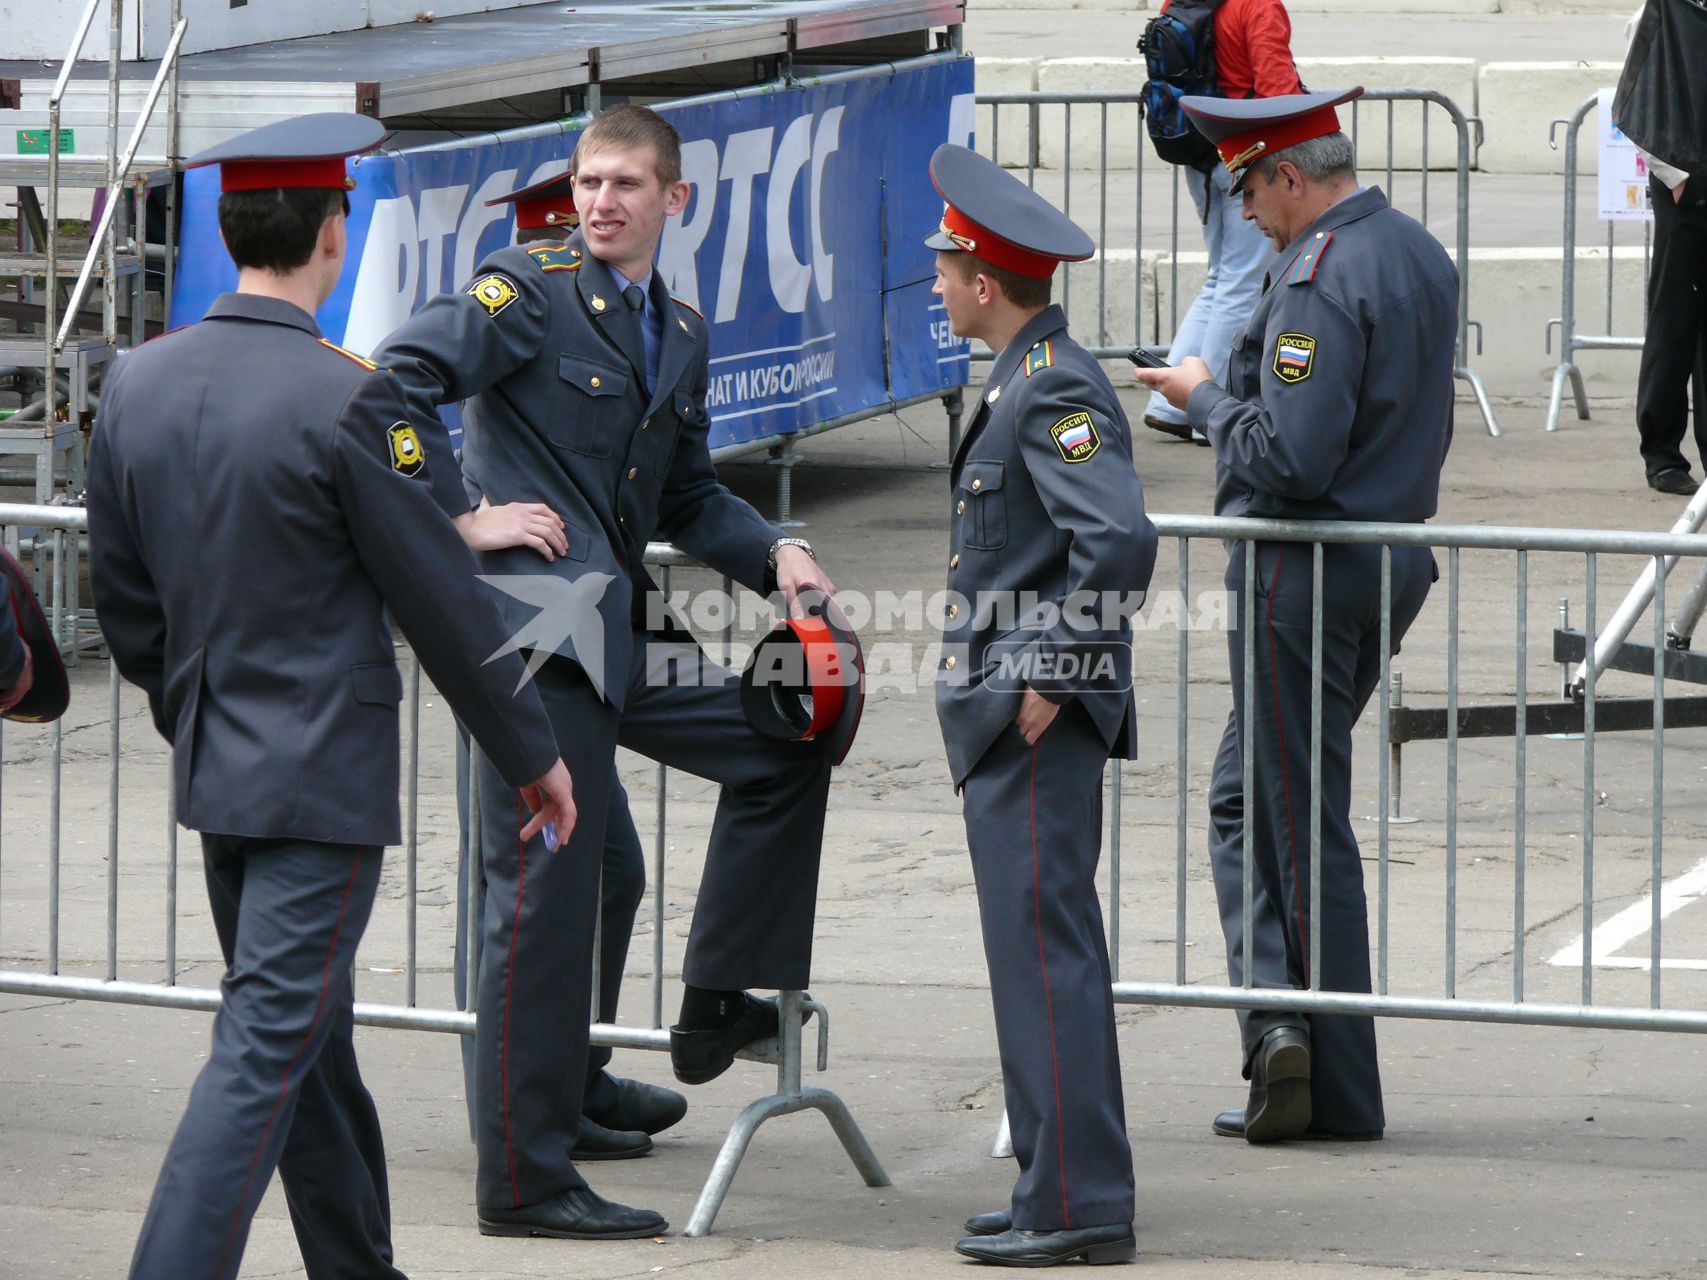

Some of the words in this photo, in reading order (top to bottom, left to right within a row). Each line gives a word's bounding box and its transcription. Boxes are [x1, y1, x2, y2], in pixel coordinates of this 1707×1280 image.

[657, 105, 845, 324] RTCC
[343, 158, 570, 358] RTC
[1280, 337, 1314, 349] РОССИЯ
[735, 371, 748, 401] И
[750, 363, 802, 399] КУБОК
[1282, 367, 1300, 376] МВД
[1053, 414, 1087, 437] РОССИЯ
[1071, 441, 1093, 458] МВД
